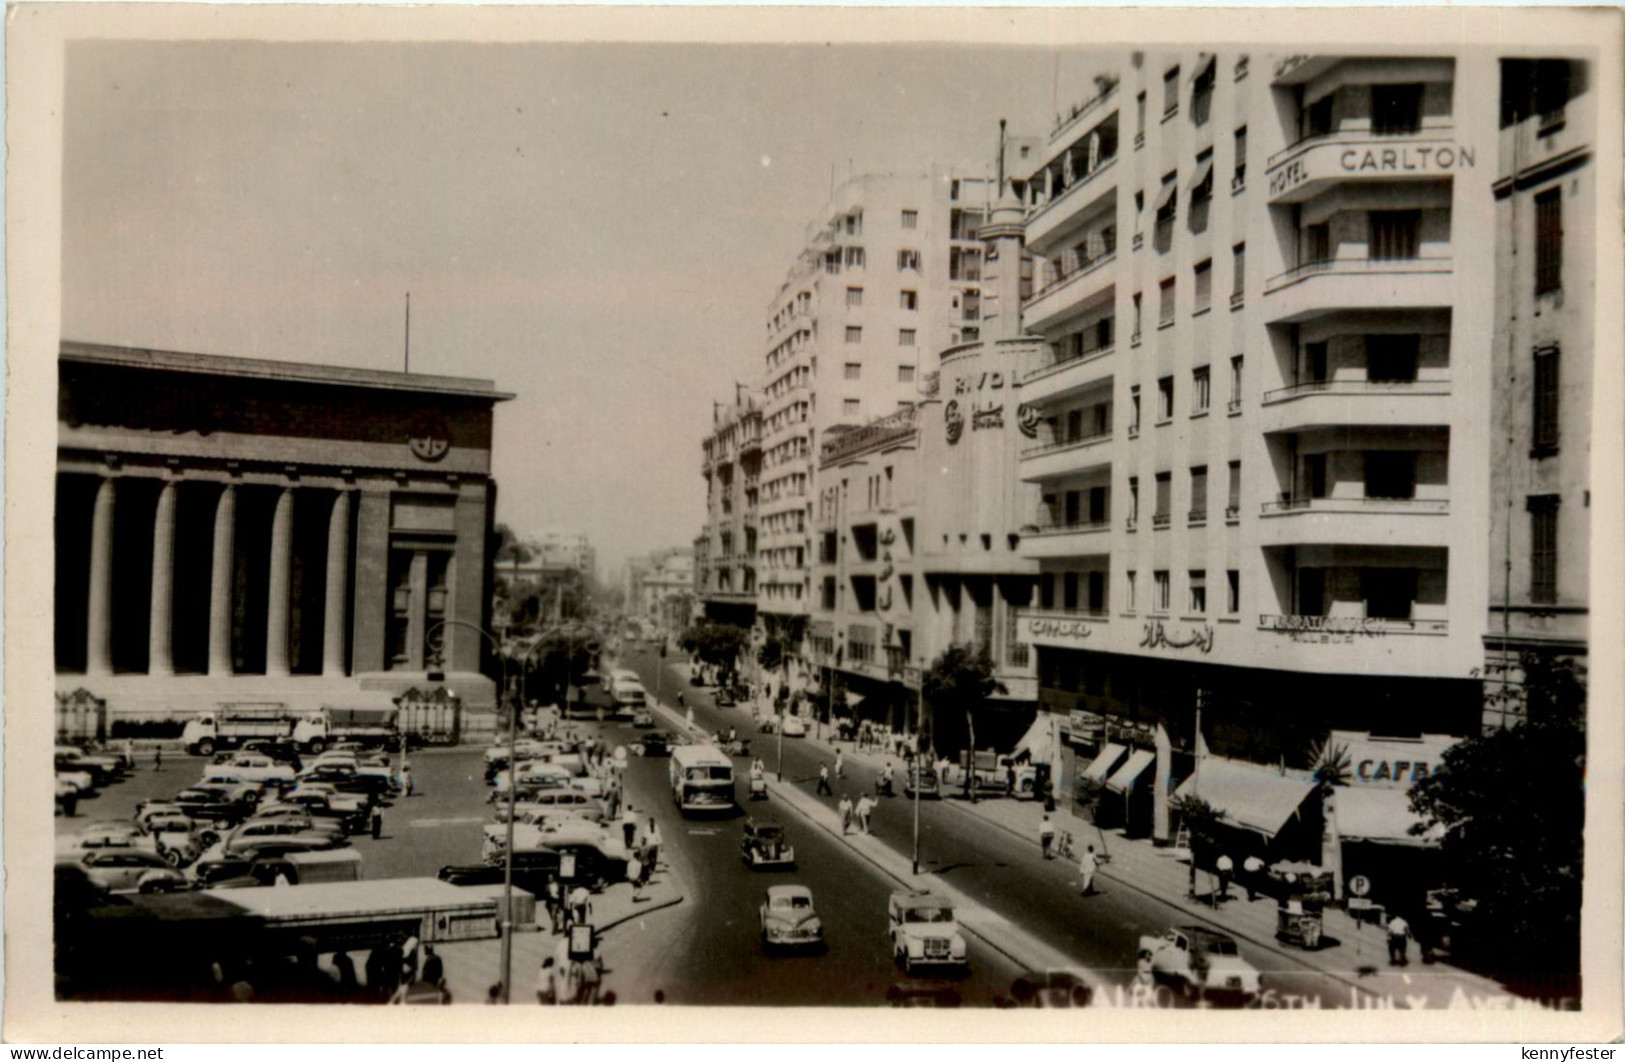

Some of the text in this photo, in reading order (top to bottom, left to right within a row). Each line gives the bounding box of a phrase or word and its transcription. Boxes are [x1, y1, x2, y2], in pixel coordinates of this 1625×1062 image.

[1269, 147, 1476, 195] HOTEL CARLTON
[955, 371, 1024, 395] RIVOL
